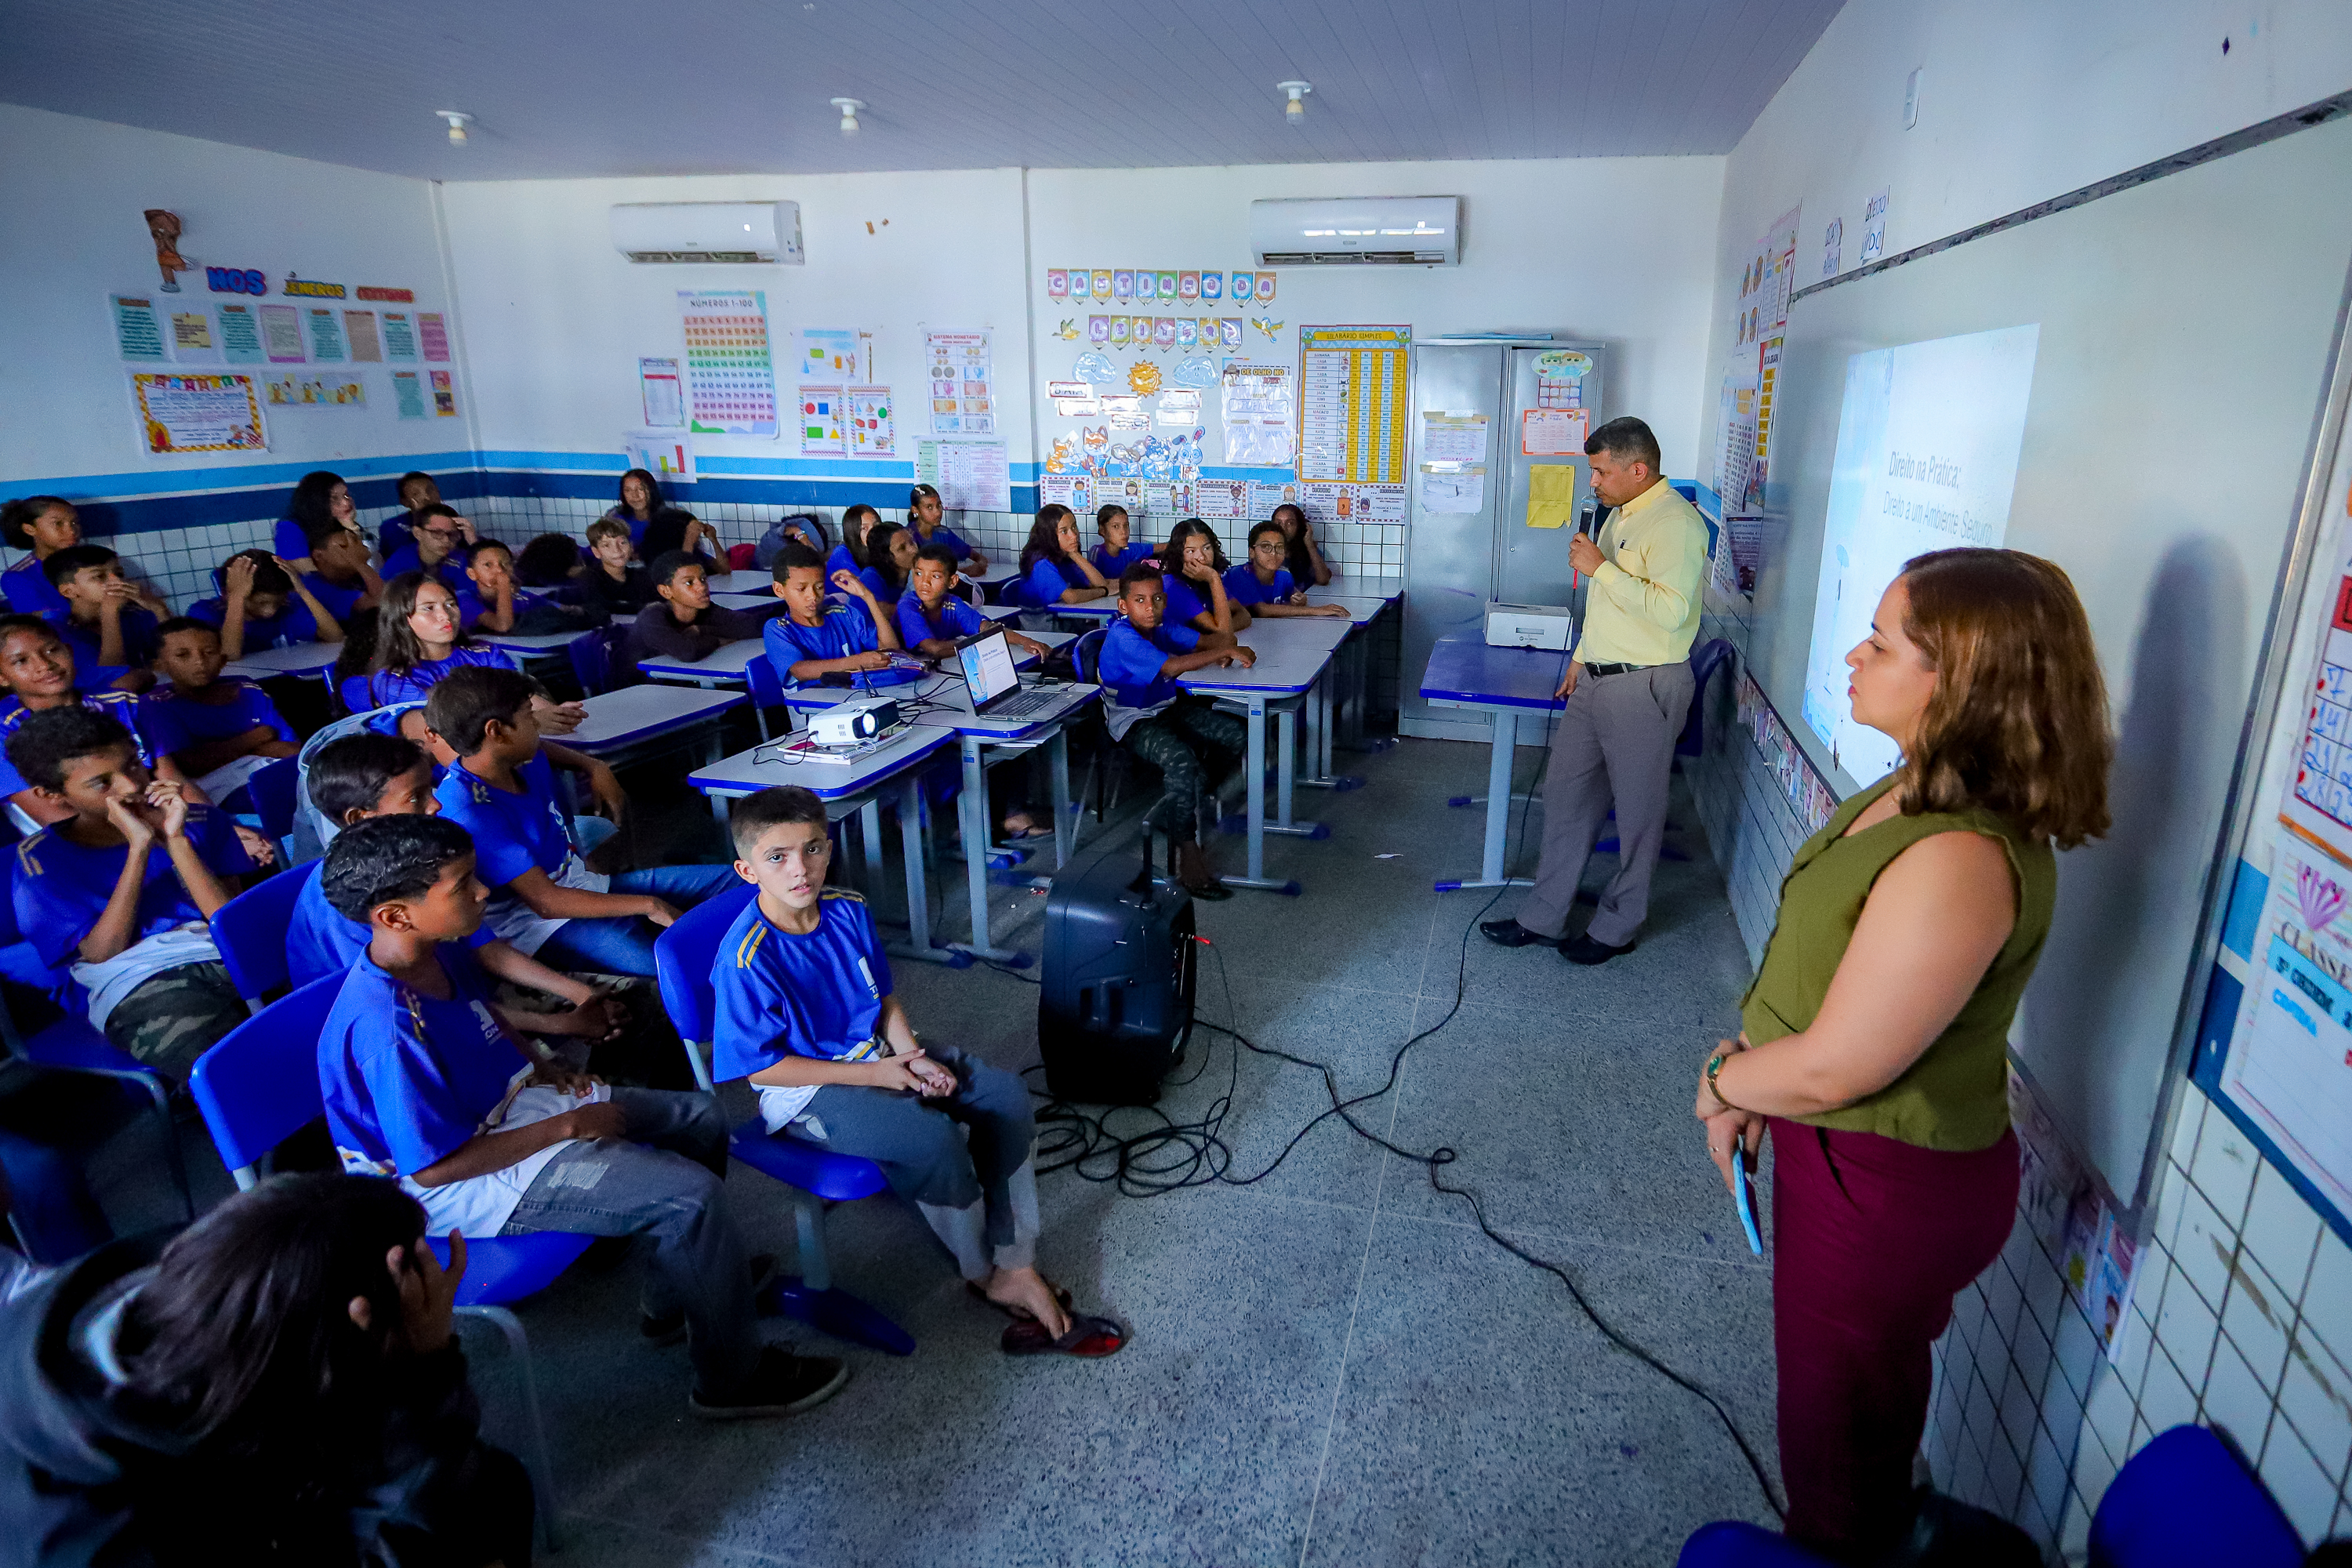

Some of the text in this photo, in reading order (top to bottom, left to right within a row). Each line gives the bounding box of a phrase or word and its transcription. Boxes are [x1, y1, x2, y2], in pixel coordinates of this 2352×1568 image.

[205, 267, 268, 296] NOS
[731, 299, 753, 307] 1-100
[1889, 451, 1962, 489] Direito na Prática:
[1883, 491, 1993, 545] Direito a um Ambiente Seguro
